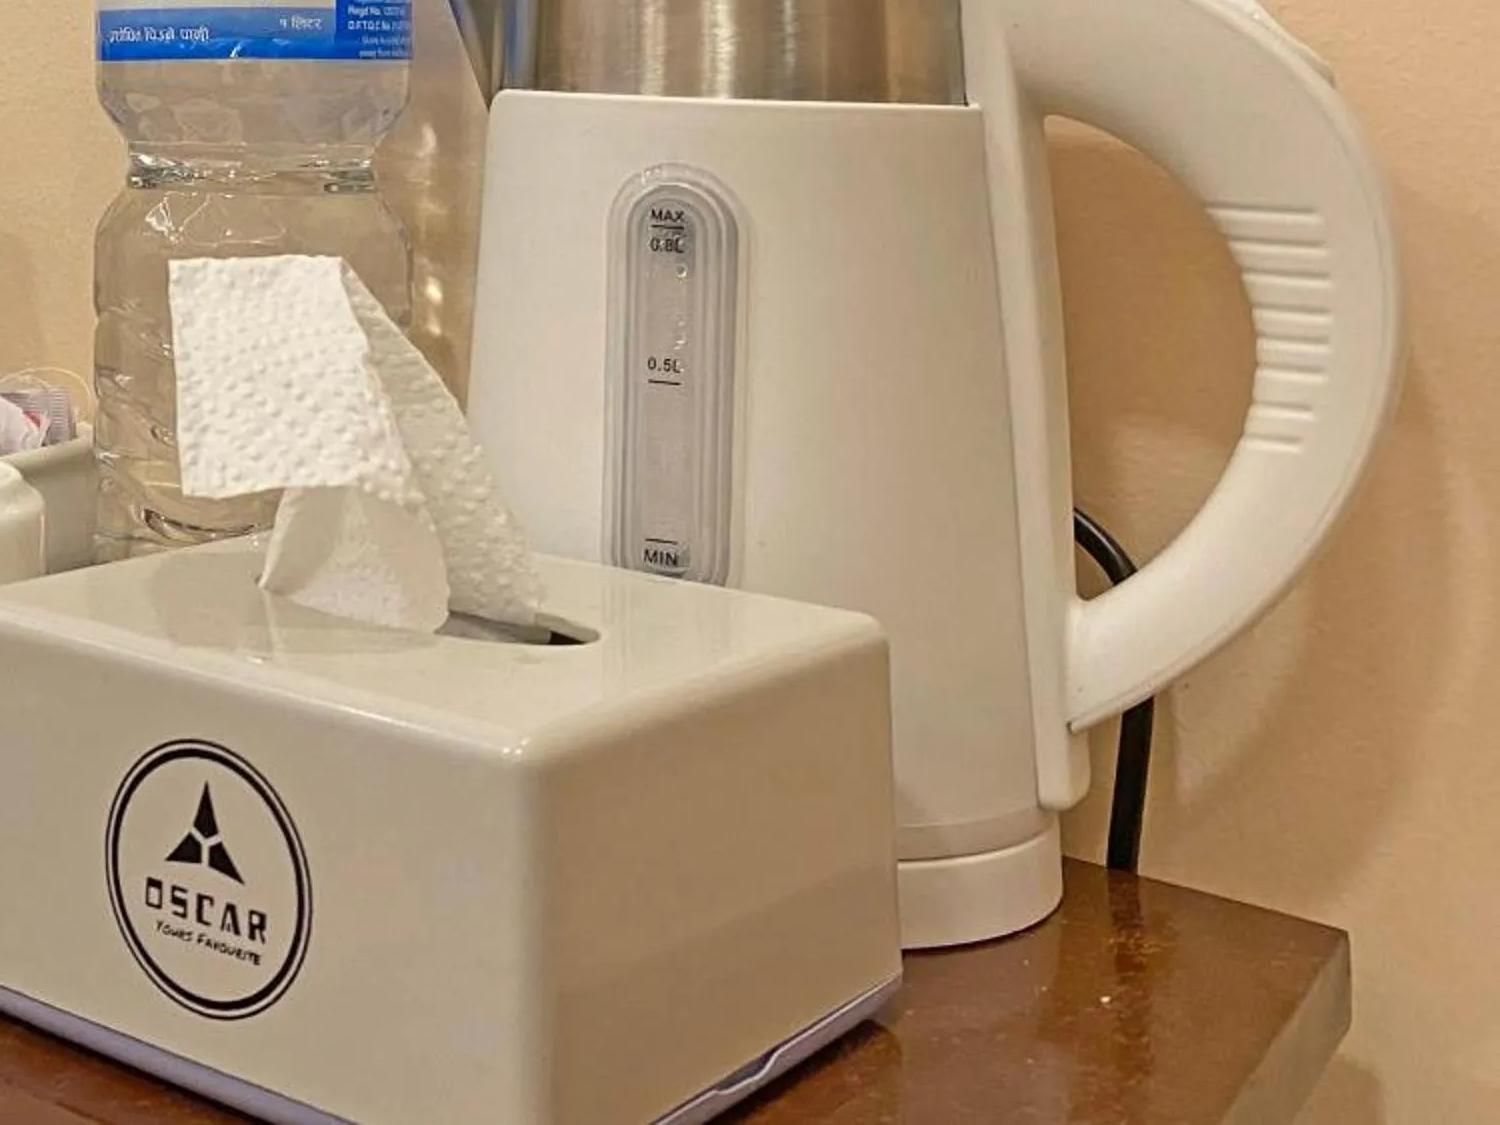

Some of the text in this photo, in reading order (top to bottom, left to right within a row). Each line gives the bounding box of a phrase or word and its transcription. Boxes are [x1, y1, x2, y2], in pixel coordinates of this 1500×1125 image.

[651, 208, 685, 222] MAX
[650, 237, 685, 254] 0.8L
[647, 357, 681, 373] 0.5L
[644, 548, 678, 566] MIN
[145, 876, 268, 945] OSCAR
